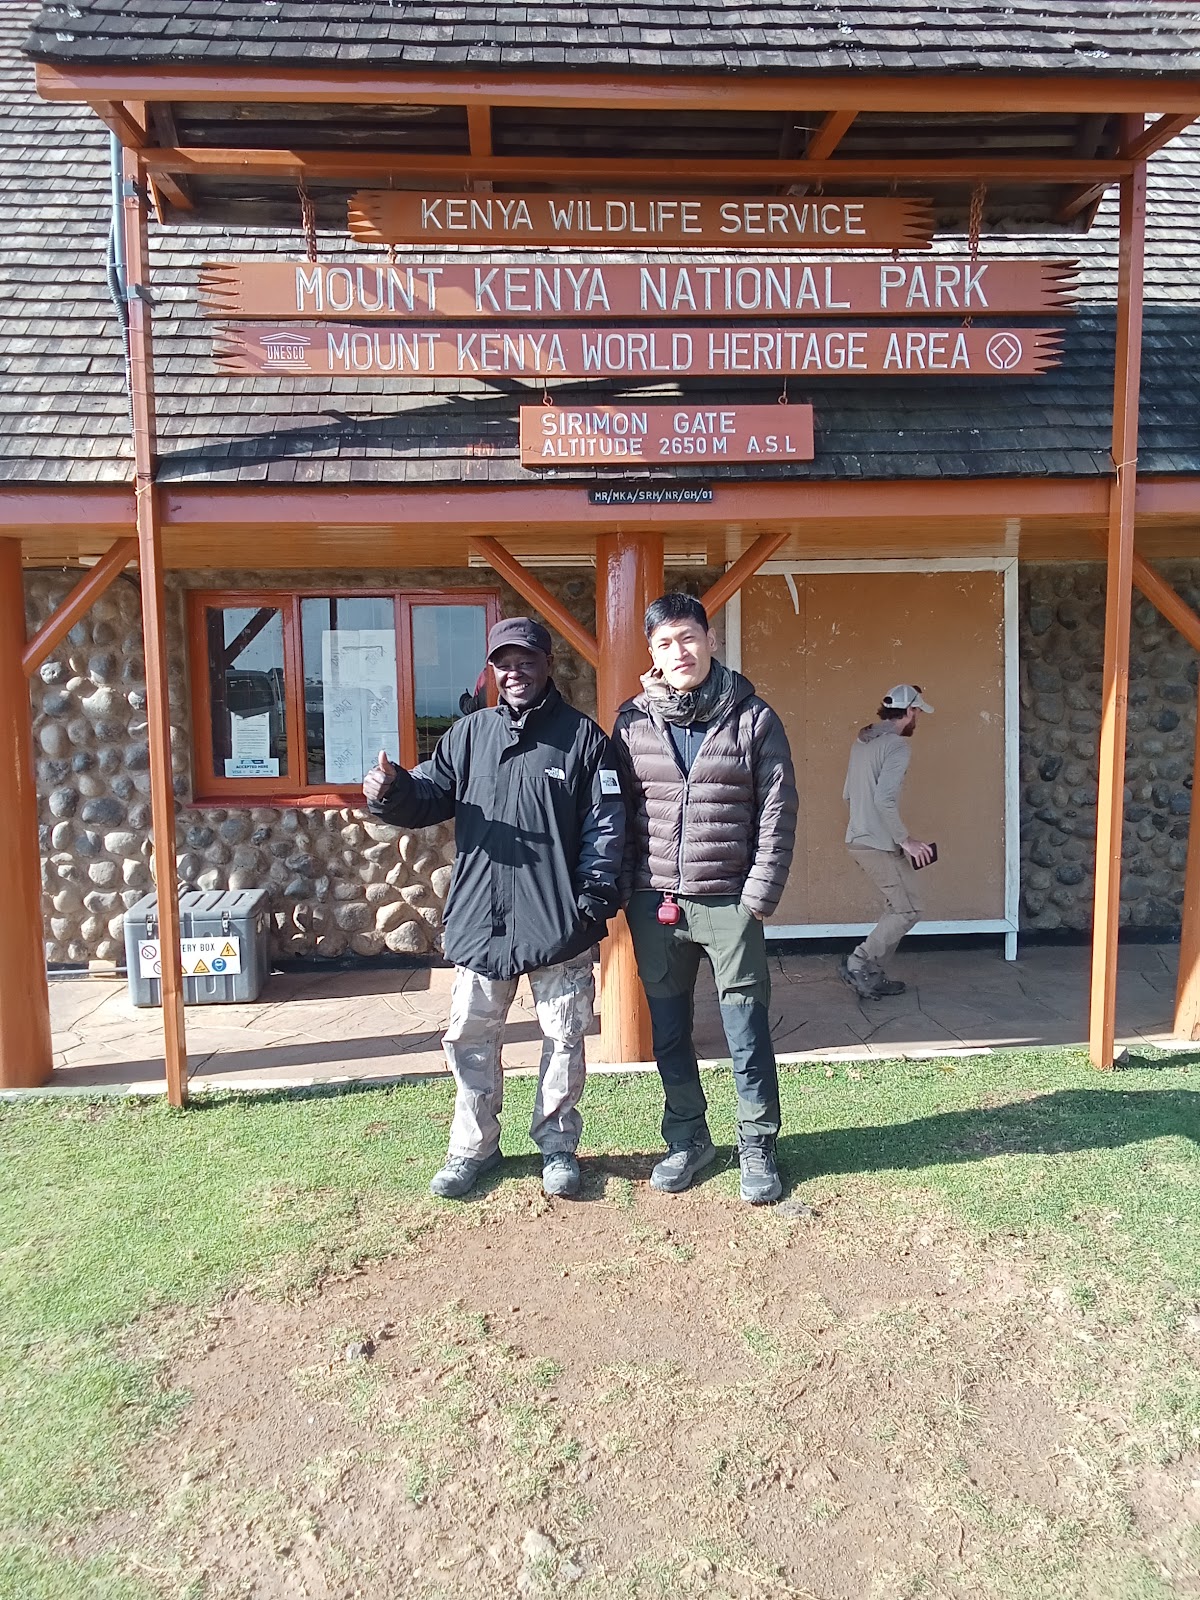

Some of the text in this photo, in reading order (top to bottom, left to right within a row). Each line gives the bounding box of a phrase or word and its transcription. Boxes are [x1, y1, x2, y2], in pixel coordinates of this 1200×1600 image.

[421, 198, 867, 235] KENYA WILDLIFE SERVICE
[295, 264, 990, 312] MOUNT KENYA NATIONAL PARK
[267, 345, 304, 360] UNESCO
[327, 331, 971, 371] MOUNT KENYA WORLD HERITAGE AREA
[541, 411, 737, 437] SIRIMON GATE
[541, 437, 643, 458] ALTITUDE
[746, 435, 797, 454] A.S.L
[595, 488, 713, 503] MR/MKA/SRM/NR/GH/01
[200, 943, 215, 951] BOX
